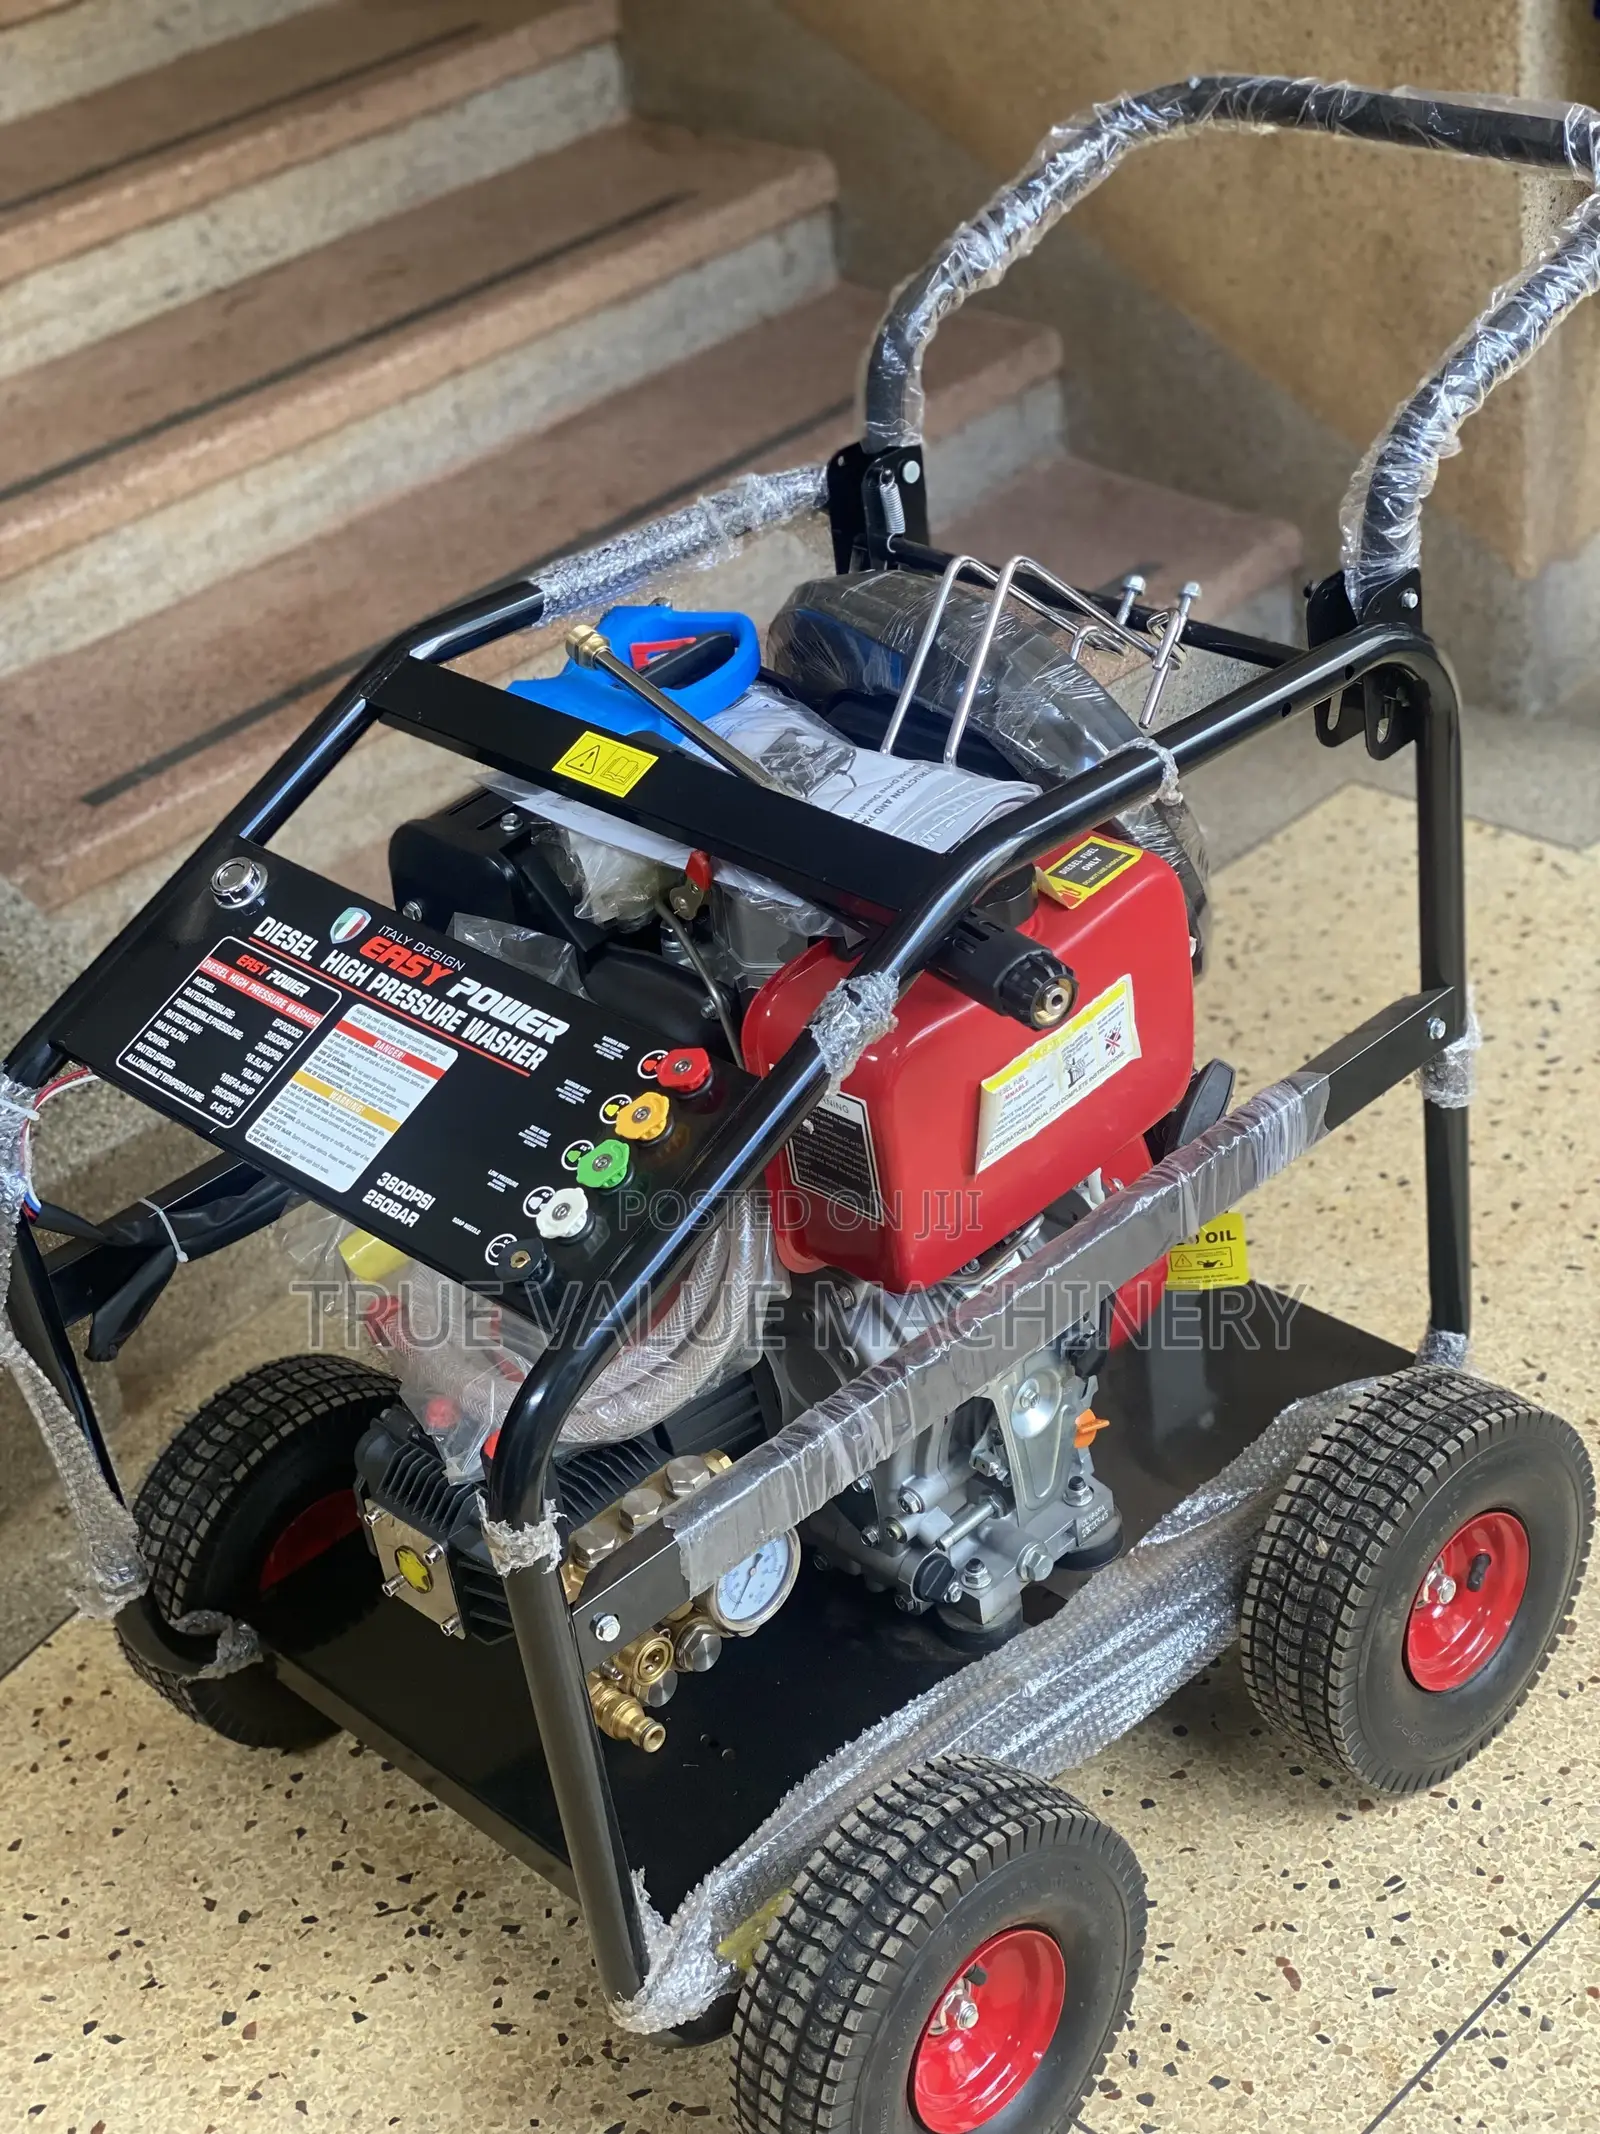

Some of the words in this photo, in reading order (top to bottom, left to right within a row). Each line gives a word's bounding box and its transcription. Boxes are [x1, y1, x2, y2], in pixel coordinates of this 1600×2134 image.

[873, 799, 893, 815] AND
[1058, 859, 1083, 875] DIESEL
[1080, 848, 1099, 860] FUEL
[1081, 856, 1102, 871] ONLY
[378, 925, 411, 946] ITALY
[413, 941, 466, 971] DESIGN
[192, 976, 218, 992] MODEL:
[235, 954, 270, 975] EASY
[265, 969, 310, 997] POWER
[201, 961, 229, 977] DIESEL
[227, 974, 248, 987] HIGH
[246, 984, 287, 1007] PRESSURE
[284, 1003, 321, 1025] WASHER
[252, 916, 320, 961] DIESEL
[319, 949, 376, 984] HIGH
[367, 974, 468, 1033] PRESSURE
[462, 1016, 548, 1072] WASHER
[359, 935, 454, 987] EASY
[446, 976, 570, 1044] POWER
[182, 987, 204, 1001] RATED
[201, 998, 236, 1018] PRESSURE:
[154, 1020, 171, 1032] MAX
[167, 1028, 189, 1042] FLOW:
[163, 1009, 185, 1024] RATED
[182, 1019, 204, 1034] FLOW:
[134, 1042, 156, 1057] RATED
[243, 1053, 272, 1071] 16.5LPM
[373, 1041, 405, 1058] DANGER!
[124, 1054, 162, 1077] ALLOWABLE
[329, 1092, 365, 1112] WARNING!
[994, 1125, 1028, 1152] OPERATION
[1028, 1110, 1049, 1129] MANUAL
[1049, 1101, 1061, 1113] FOR
[1060, 1080, 1088, 1104] COMPLETE
[375, 1170, 437, 1211] 3800PSI
[362, 1189, 421, 1229] 250BAR
[1205, 1230, 1237, 1243] OIL
